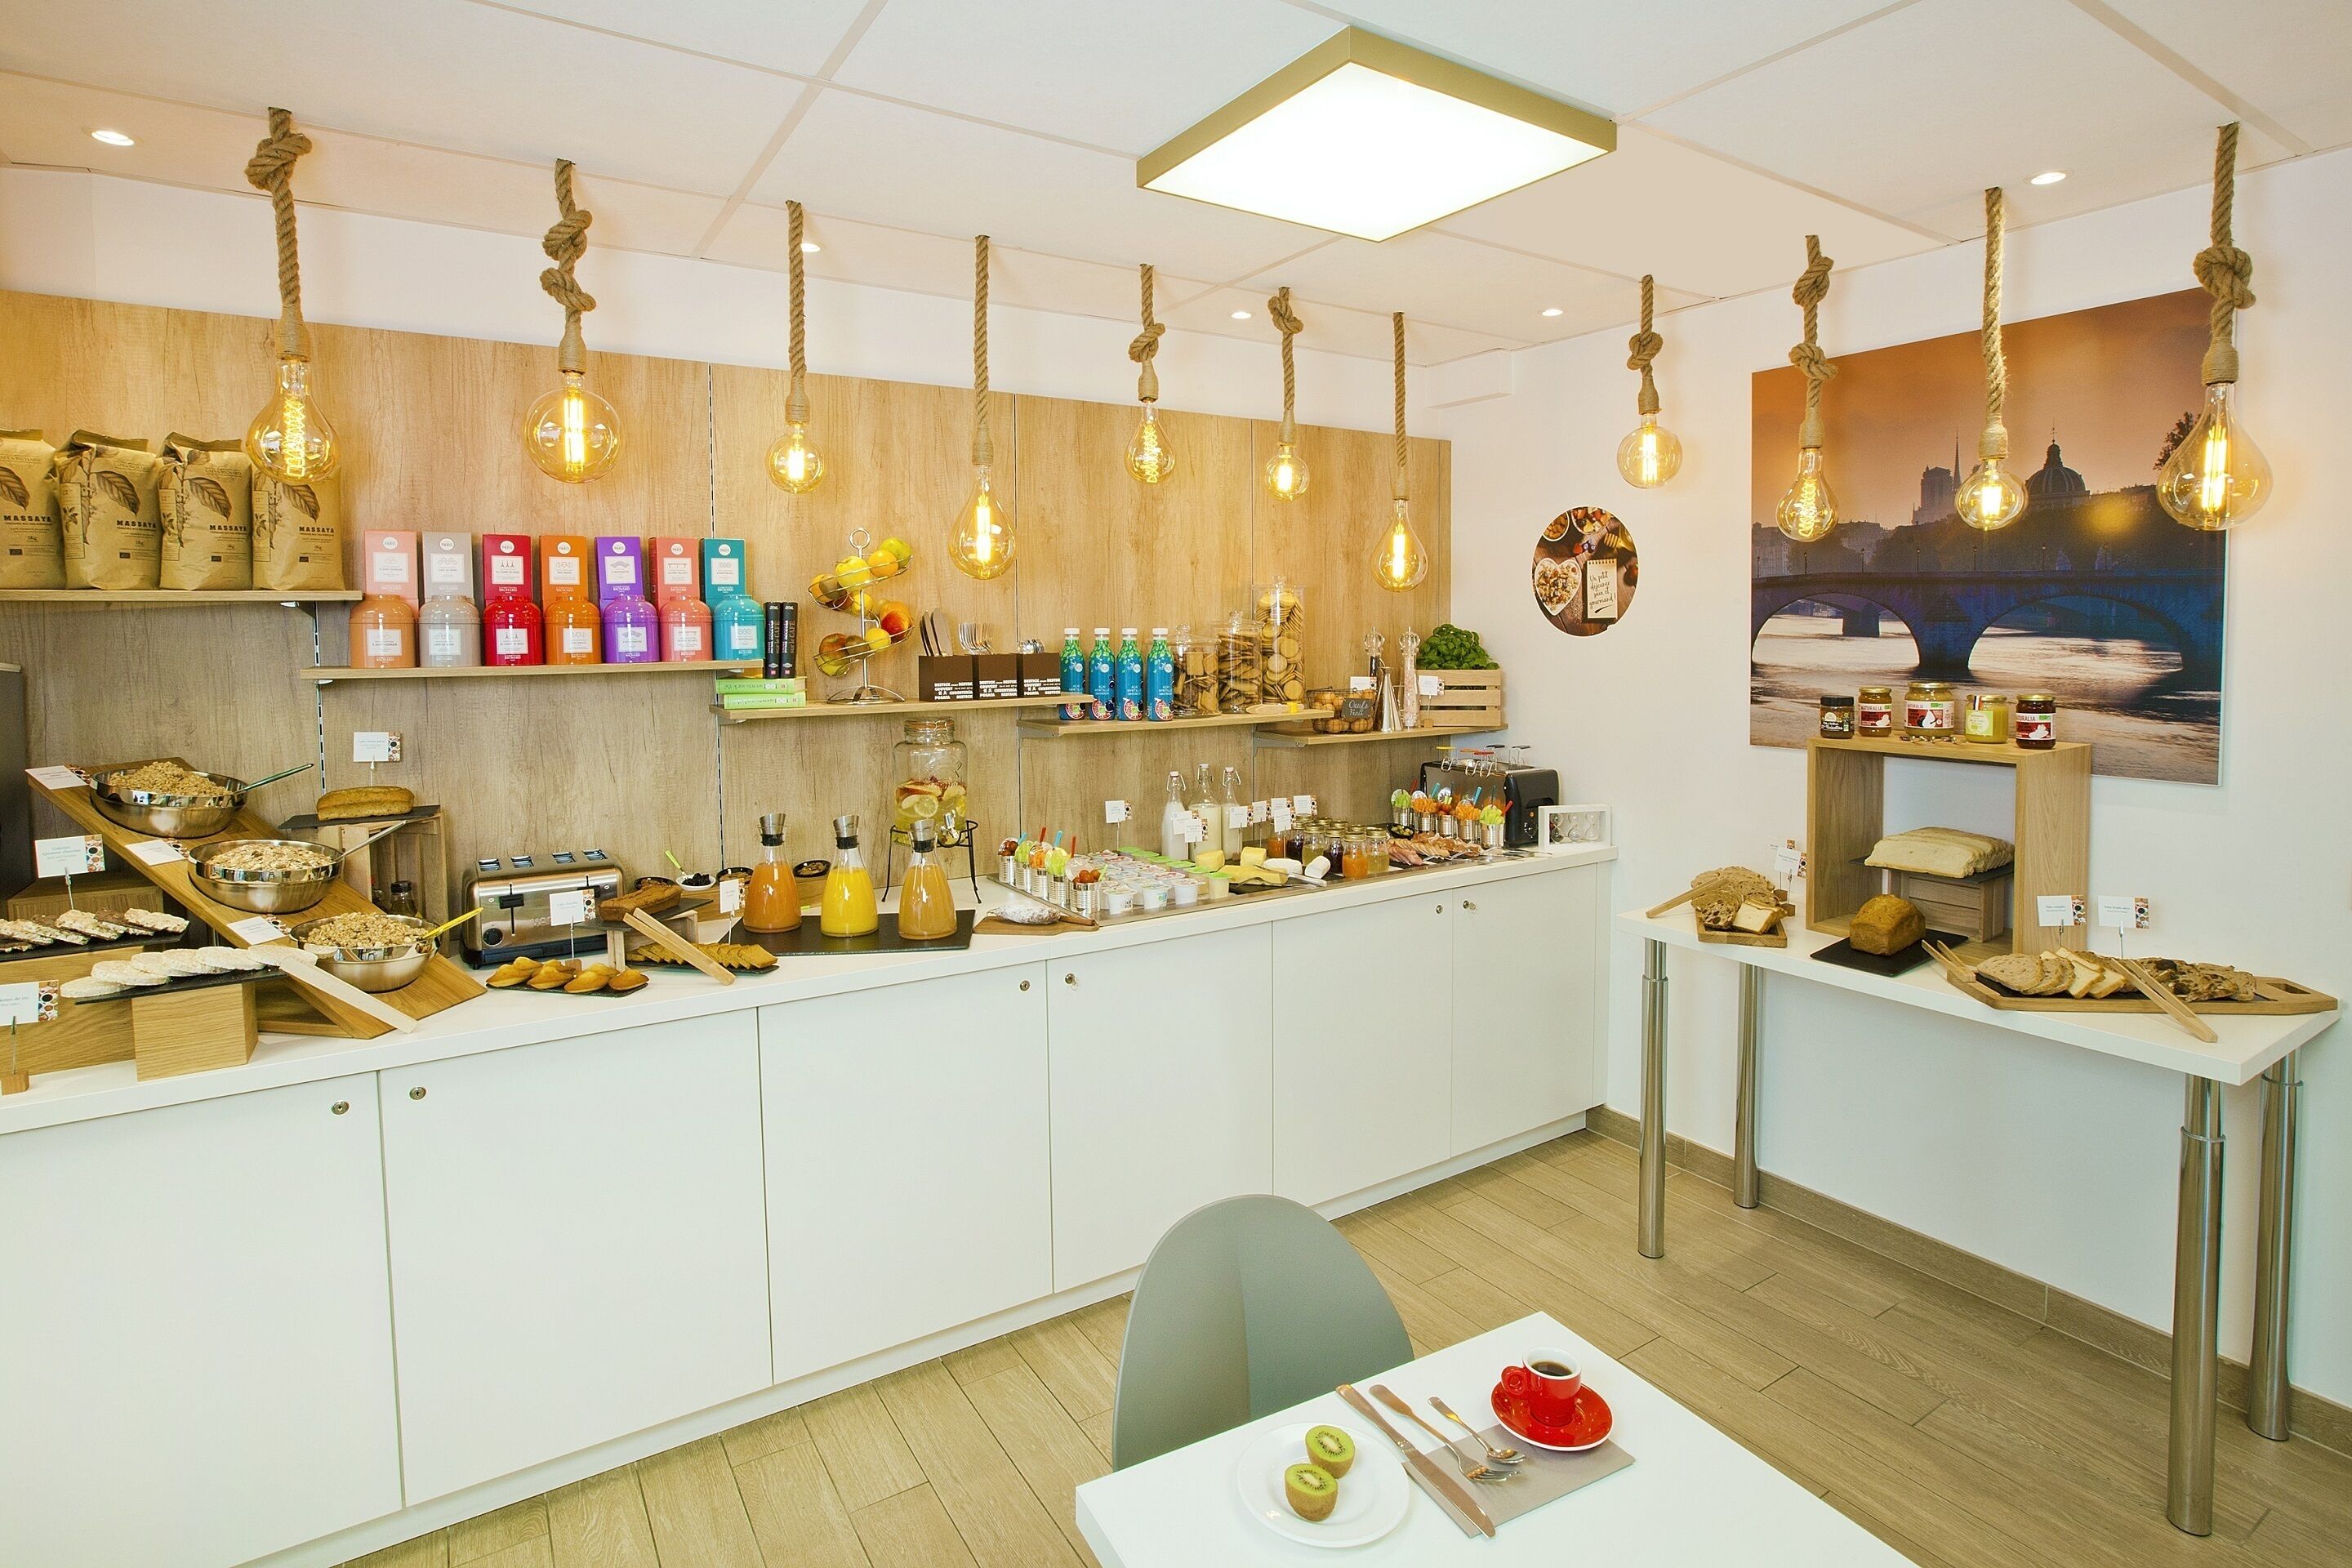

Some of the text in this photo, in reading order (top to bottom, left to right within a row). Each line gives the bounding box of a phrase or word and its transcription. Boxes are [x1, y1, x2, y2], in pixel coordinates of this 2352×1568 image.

[3, 514, 52, 523] MASSAYA
[116, 519, 157, 528] MASSAYA
[1598, 571, 1608, 582] petit
